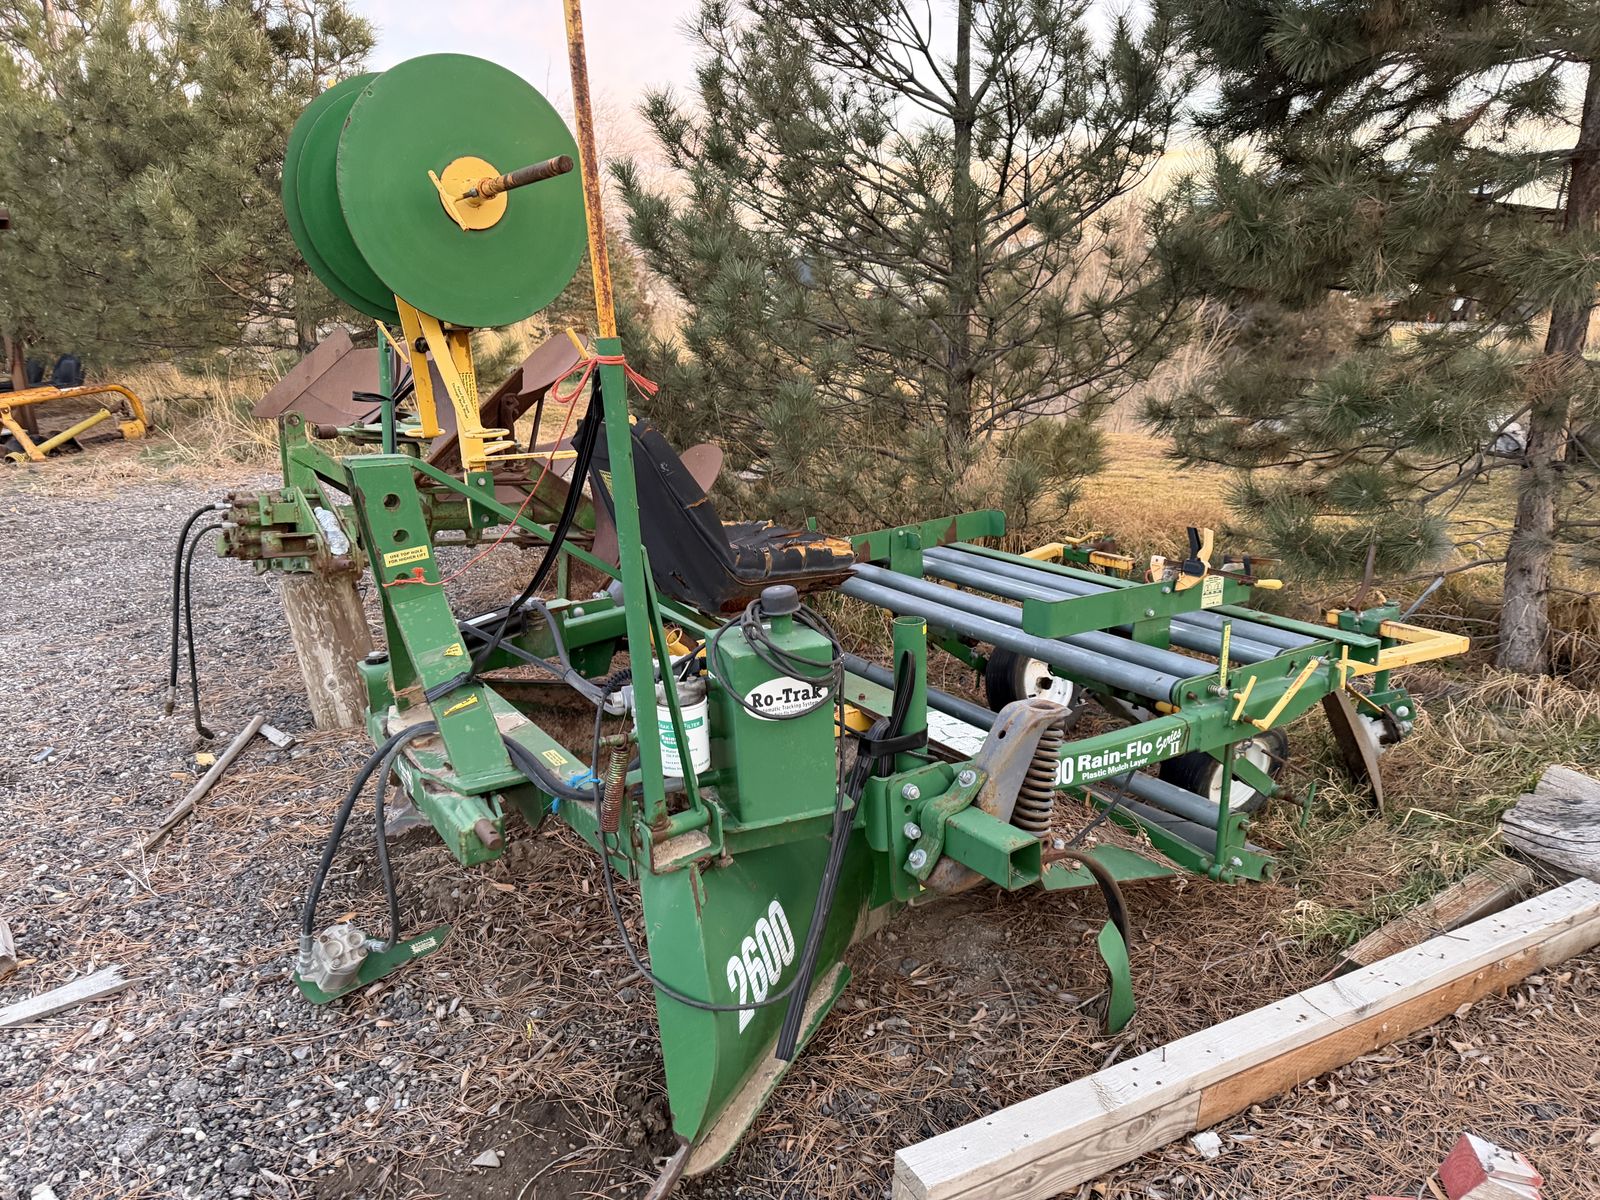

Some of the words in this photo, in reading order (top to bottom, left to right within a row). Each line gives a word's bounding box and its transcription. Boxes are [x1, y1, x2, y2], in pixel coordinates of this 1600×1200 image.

[751, 686, 822, 709] Ro-Trak
[782, 702, 801, 711] Tracking
[1155, 728, 1182, 756] Series
[1169, 740, 1180, 756] II
[1077, 740, 1153, 772] Rain-Flo
[1082, 769, 1107, 781] Plastic
[1108, 763, 1129, 775] Mulch
[1130, 757, 1148, 769] Layer
[727, 900, 795, 1034] 2600
